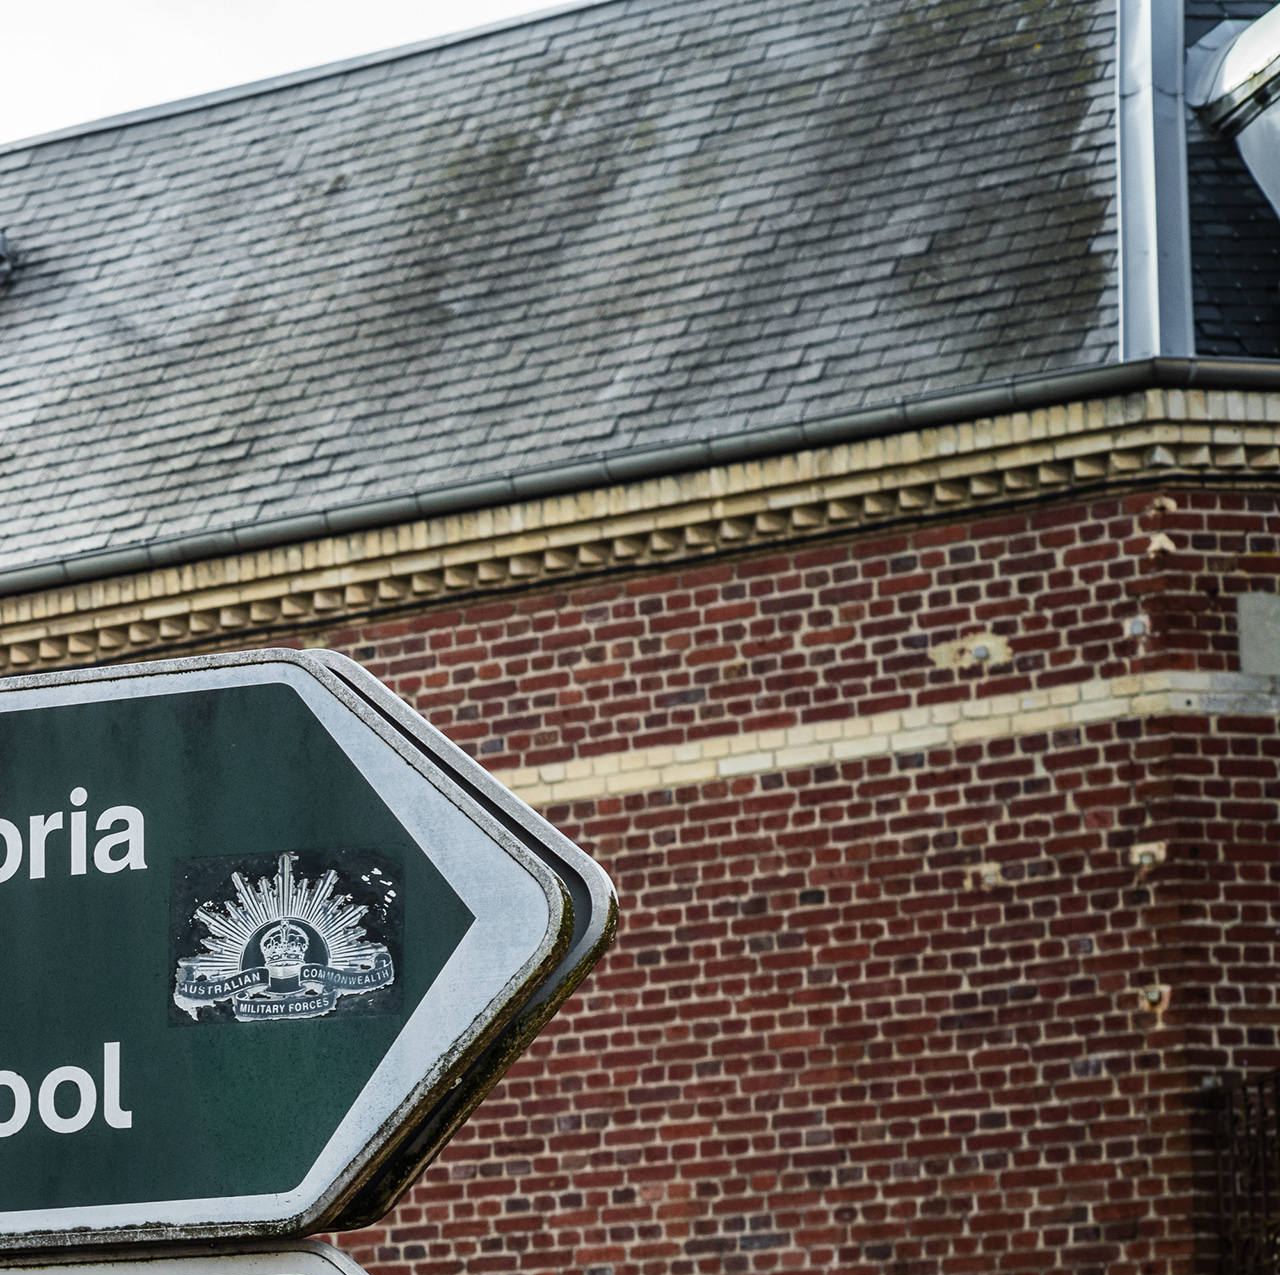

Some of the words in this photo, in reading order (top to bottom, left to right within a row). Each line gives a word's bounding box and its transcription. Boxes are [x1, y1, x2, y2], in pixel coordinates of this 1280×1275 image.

[181, 972, 261, 995] AUSTRALIAN
[302, 968, 390, 985] COMMONWEALTH
[240, 1003, 285, 1014] MILITARY
[288, 997, 329, 1013] FORCES
